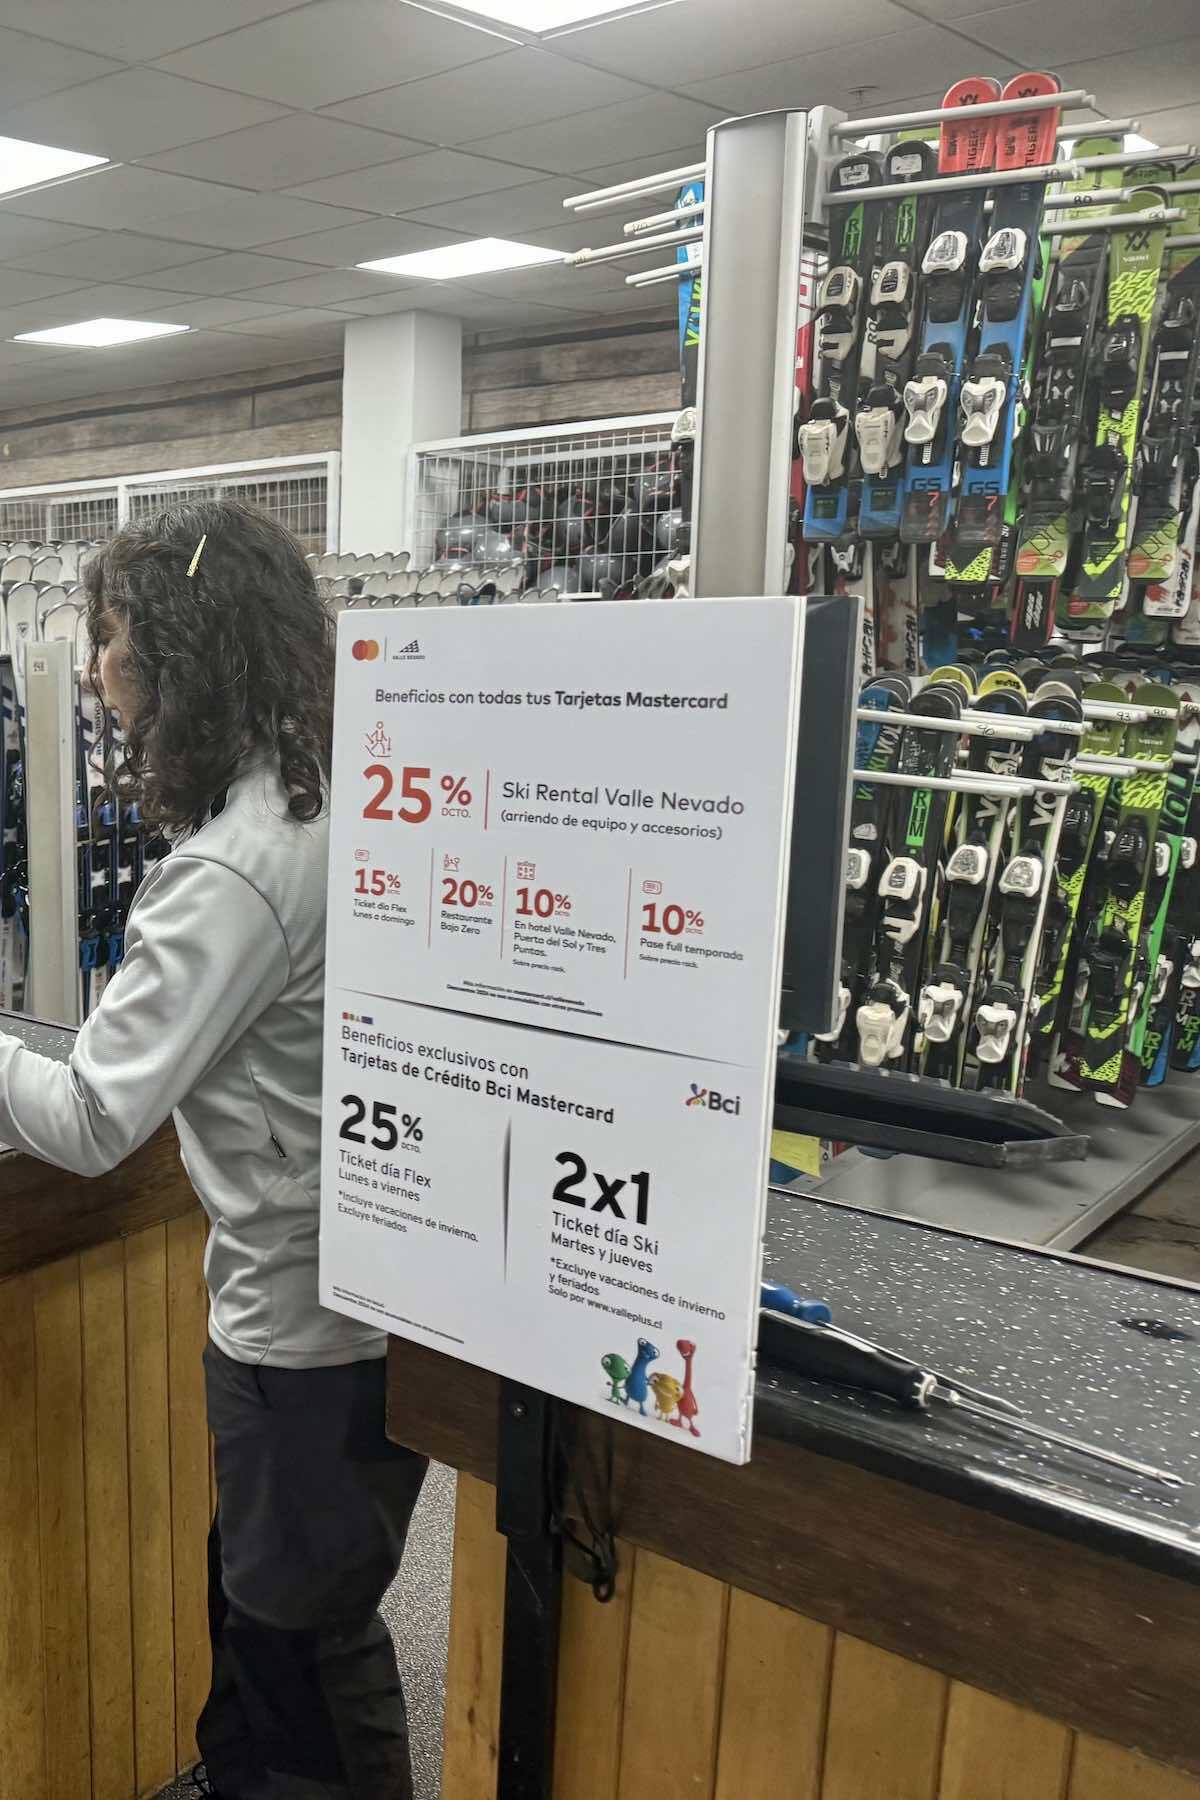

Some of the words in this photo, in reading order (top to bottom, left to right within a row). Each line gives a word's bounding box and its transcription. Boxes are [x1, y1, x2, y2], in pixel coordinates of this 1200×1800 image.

[375, 688, 445, 703] Beneficios
[449, 692, 474, 704] con
[479, 690, 522, 705] todas
[526, 692, 551, 705] tus
[554, 691, 622, 710] Tarjetas
[626, 692, 728, 709] Mastercard
[362, 764, 472, 824] 25%
[502, 782, 530, 800] Ski
[536, 782, 598, 804] Rental
[604, 787, 654, 808] Valle
[661, 791, 744, 815] Nevado
[441, 808, 472, 818] DCTO.
[500, 810, 558, 825] (arriendo
[562, 814, 578, 826] de
[582, 817, 627, 832] equipo
[630, 822, 639, 834] y
[641, 822, 723, 840] accesorios)
[909, 789, 929, 837] RTM
[354, 868, 401, 896] 15%
[442, 878, 494, 908] 20%
[353, 909, 373, 920] lunes
[380, 914, 416, 926] domingo
[354, 898, 376, 909] Ticket
[391, 903, 407, 913] Flex
[440, 910, 493, 924] Restaurante
[516, 888, 572, 918] 10%
[440, 922, 460, 932] Bajo
[460, 924, 480, 934] Zero
[514, 920, 526, 930] En
[528, 922, 552, 933] hotel
[553, 926, 576, 936] Valle
[642, 902, 704, 936] 10%
[514, 932, 544, 944] Puerta
[546, 936, 560, 946] del
[562, 939, 577, 949] Sol
[578, 943, 584, 952] y
[586, 942, 606, 954] Tres
[640, 938, 664, 950] Pase
[666, 941, 683, 952] full
[684, 945, 744, 961] temporada
[341, 1025, 414, 1054] Beneficios
[418, 1045, 496, 1073] exclusivos
[500, 1062, 529, 1080] con
[340, 1046, 398, 1073] Tarjetas
[402, 1062, 420, 1078] de
[424, 1066, 481, 1092] Crédito
[486, 1080, 512, 1100] Bci
[516, 1086, 614, 1124] Mastercard
[708, 1090, 741, 1116] Bci
[339, 1094, 424, 1151] 25%
[339, 1149, 378, 1172] Ticket
[380, 1162, 400, 1180] día
[404, 1168, 432, 1188] Flex
[338, 1168, 370, 1186] Lunes
[372, 1180, 378, 1190] a
[381, 1180, 421, 1202] viernes
[552, 1151, 650, 1226] 2x1
[338, 1202, 371, 1222] Excluye
[372, 1212, 408, 1233] feriados
[375, 1202, 423, 1224] vacaciones
[425, 1216, 437, 1229] de
[438, 1220, 478, 1242] invierno.
[552, 1210, 600, 1239] Ticket
[604, 1227, 629, 1247] día
[634, 1234, 659, 1256] Ski
[551, 1232, 596, 1256] Martes
[599, 1247, 606, 1262] y
[608, 1249, 653, 1274] jueves
[549, 1272, 556, 1283] y
[558, 1273, 600, 1296] feriados
[598, 1272, 659, 1300] vacaciones
[662, 1291, 676, 1304] de
[678, 1296, 726, 1320] invierno
[548, 1284, 568, 1298] Solo
[570, 1292, 585, 1304] por
[587, 1299, 663, 1330] www.valleplus.cl
